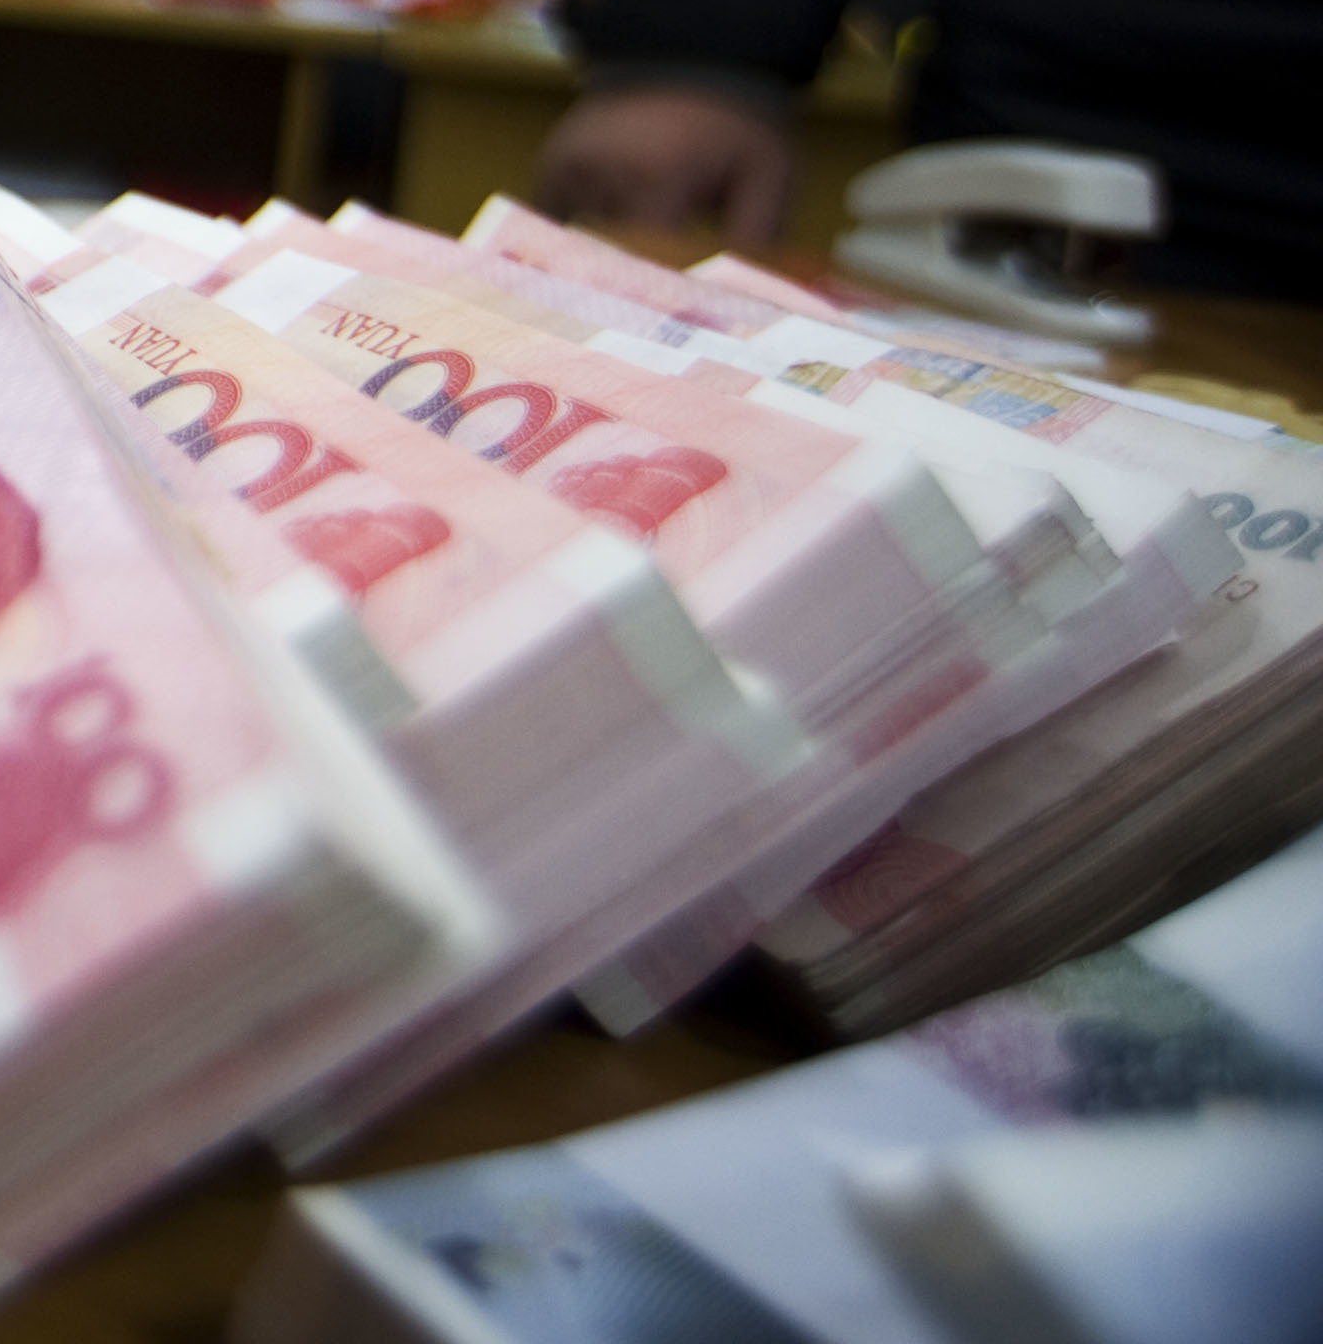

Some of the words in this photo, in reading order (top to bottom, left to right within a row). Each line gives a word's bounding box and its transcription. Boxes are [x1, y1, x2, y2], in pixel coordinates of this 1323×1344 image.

[108, 321, 198, 376] YUAN
[321, 312, 421, 360] YUAN
[129, 369, 365, 515] 100
[359, 348, 622, 477] 100
